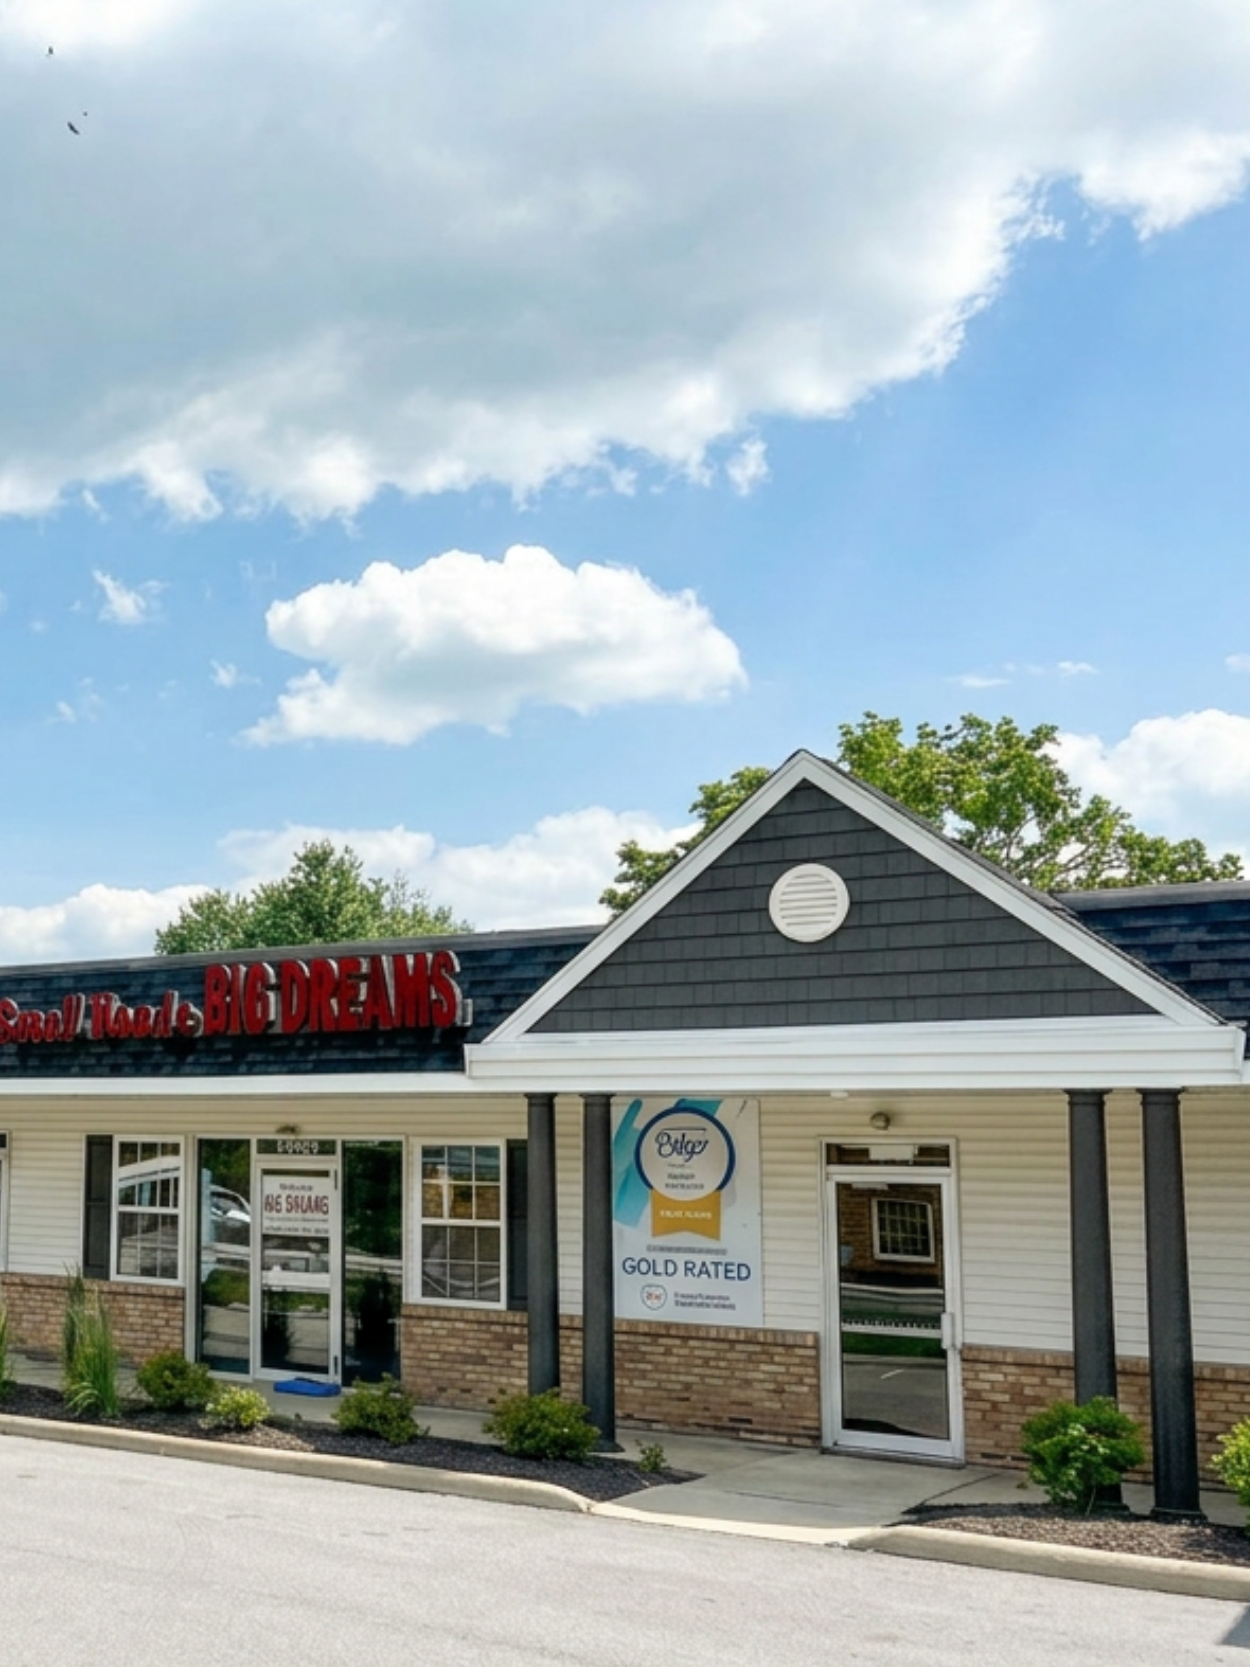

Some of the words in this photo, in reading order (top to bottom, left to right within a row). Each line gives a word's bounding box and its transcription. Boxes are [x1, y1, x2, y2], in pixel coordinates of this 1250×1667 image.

[203, 961, 277, 1036] BIG
[279, 949, 461, 1034] DREAMS
[621, 1256, 679, 1277] GOLD
[683, 1259, 752, 1282] RATED
